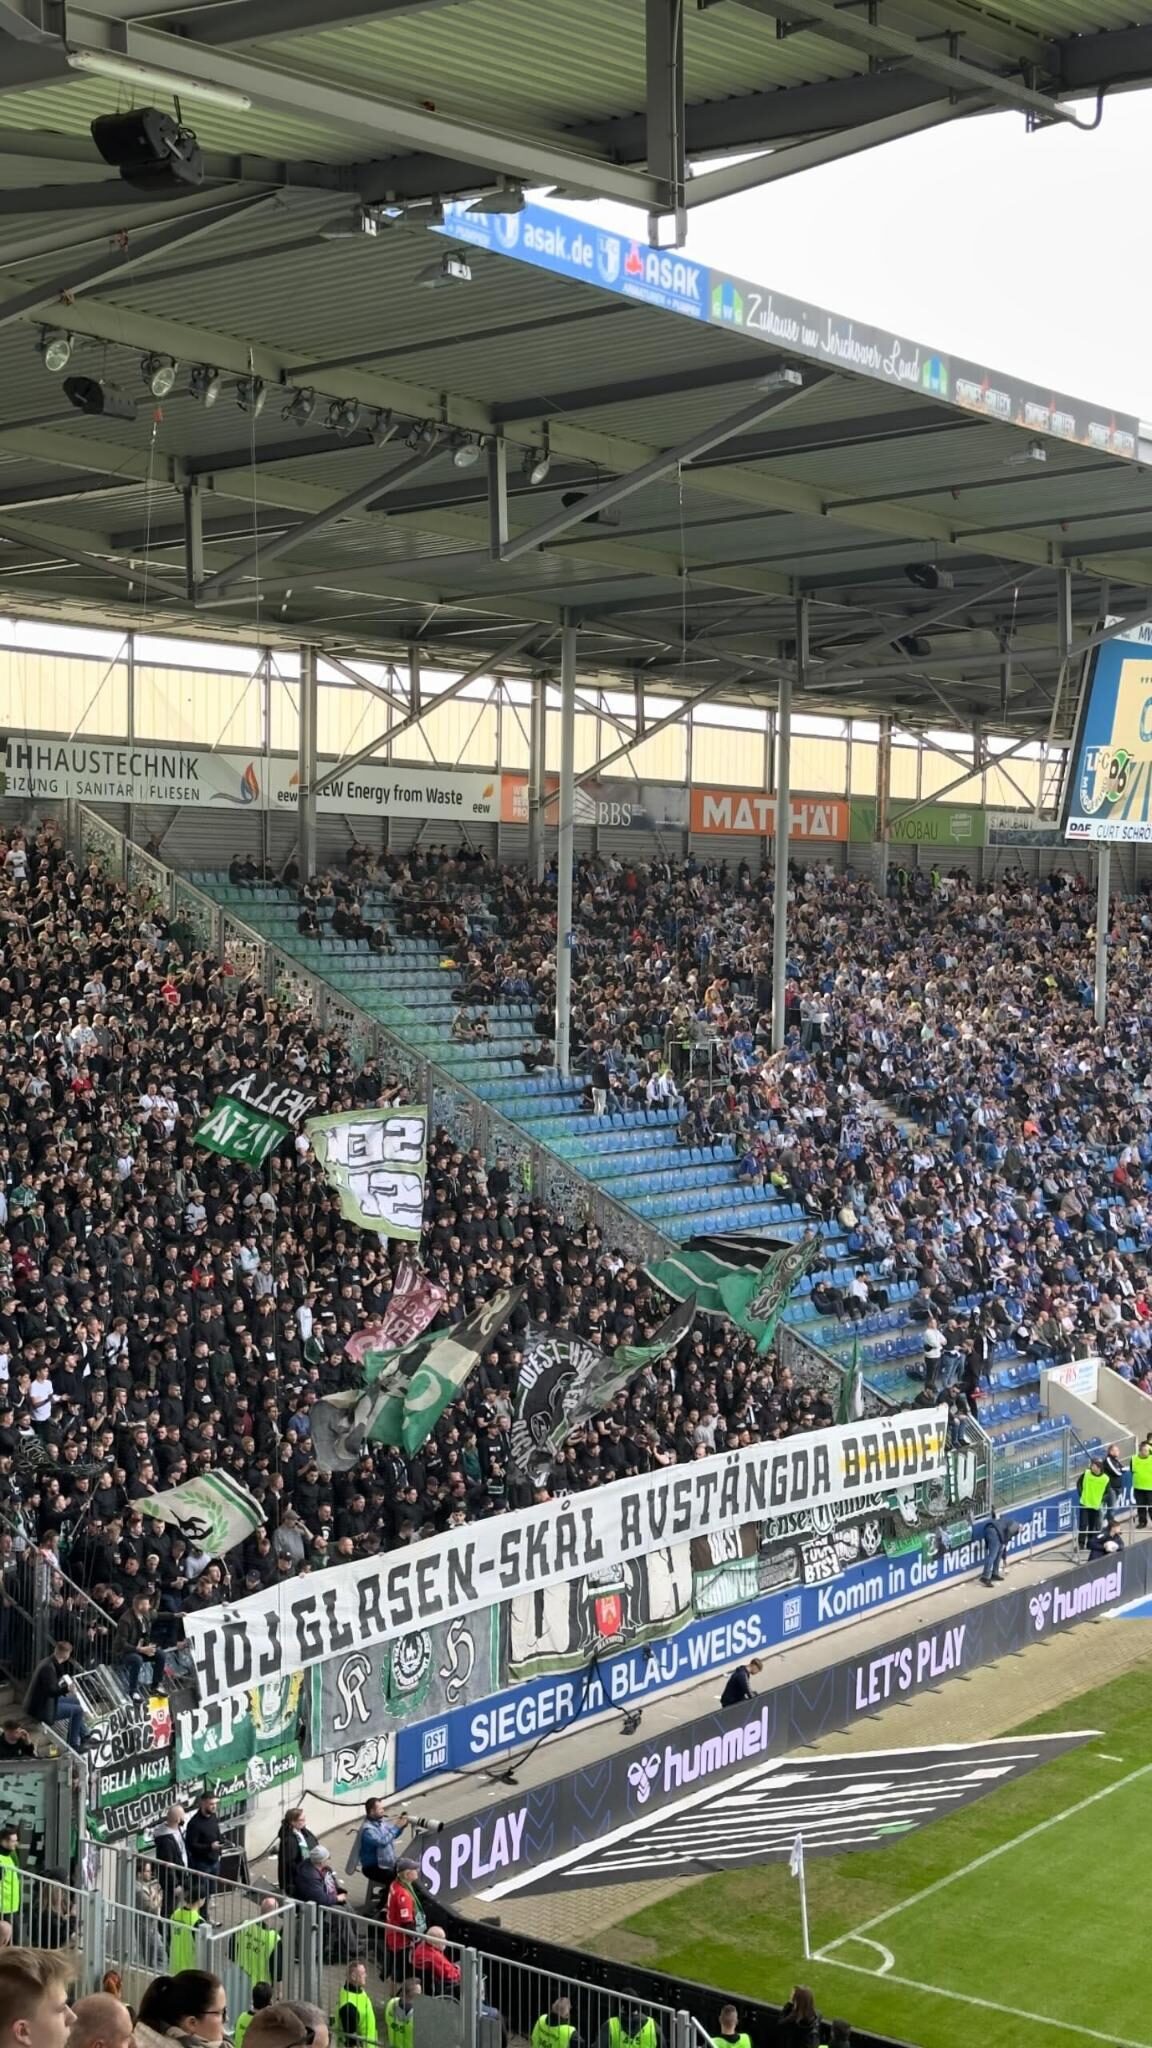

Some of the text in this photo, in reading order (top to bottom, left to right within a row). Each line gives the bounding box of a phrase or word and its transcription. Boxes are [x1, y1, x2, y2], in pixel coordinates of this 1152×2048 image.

[524, 222, 593, 269] asak.de
[646, 254, 700, 299] ASAK
[747, 293, 800, 342] Zuhause
[802, 312, 819, 348] im
[821, 318, 882, 369] Jerichower
[884, 339, 920, 383] Land
[150, 785, 200, 801] FLIESEN
[277, 790, 298, 803] eew
[347, 782, 391, 804] Energy
[394, 785, 423, 803] from
[426, 787, 463, 806] Waste
[472, 802, 491, 814] eew
[597, 802, 632, 826] BBS
[894, 820, 938, 841] WOBAU
[1069, 823, 1152, 841] DAF CURT SCHRÖ
[519, 1338, 562, 1390] WEST
[620, 1444, 831, 1551] AVSTÄNGDA
[785, 1600, 801, 1616] OST
[817, 1577, 884, 1622] Komm
[888, 1565, 904, 1594] in
[910, 1553, 939, 1586] die
[1053, 1561, 1122, 1624] hummel
[855, 1625, 966, 1710] LET'S PLAY
[469, 1682, 575, 1754] SIEGER
[582, 1676, 603, 1712] in
[424, 1748, 447, 1768] BAU
[426, 1731, 446, 1748] OST
[664, 1706, 769, 1791] hummel
[101, 1755, 171, 1796] BELLA VISTA
[261, 1753, 298, 1785] Society
[450, 1807, 528, 1889] PLAY
